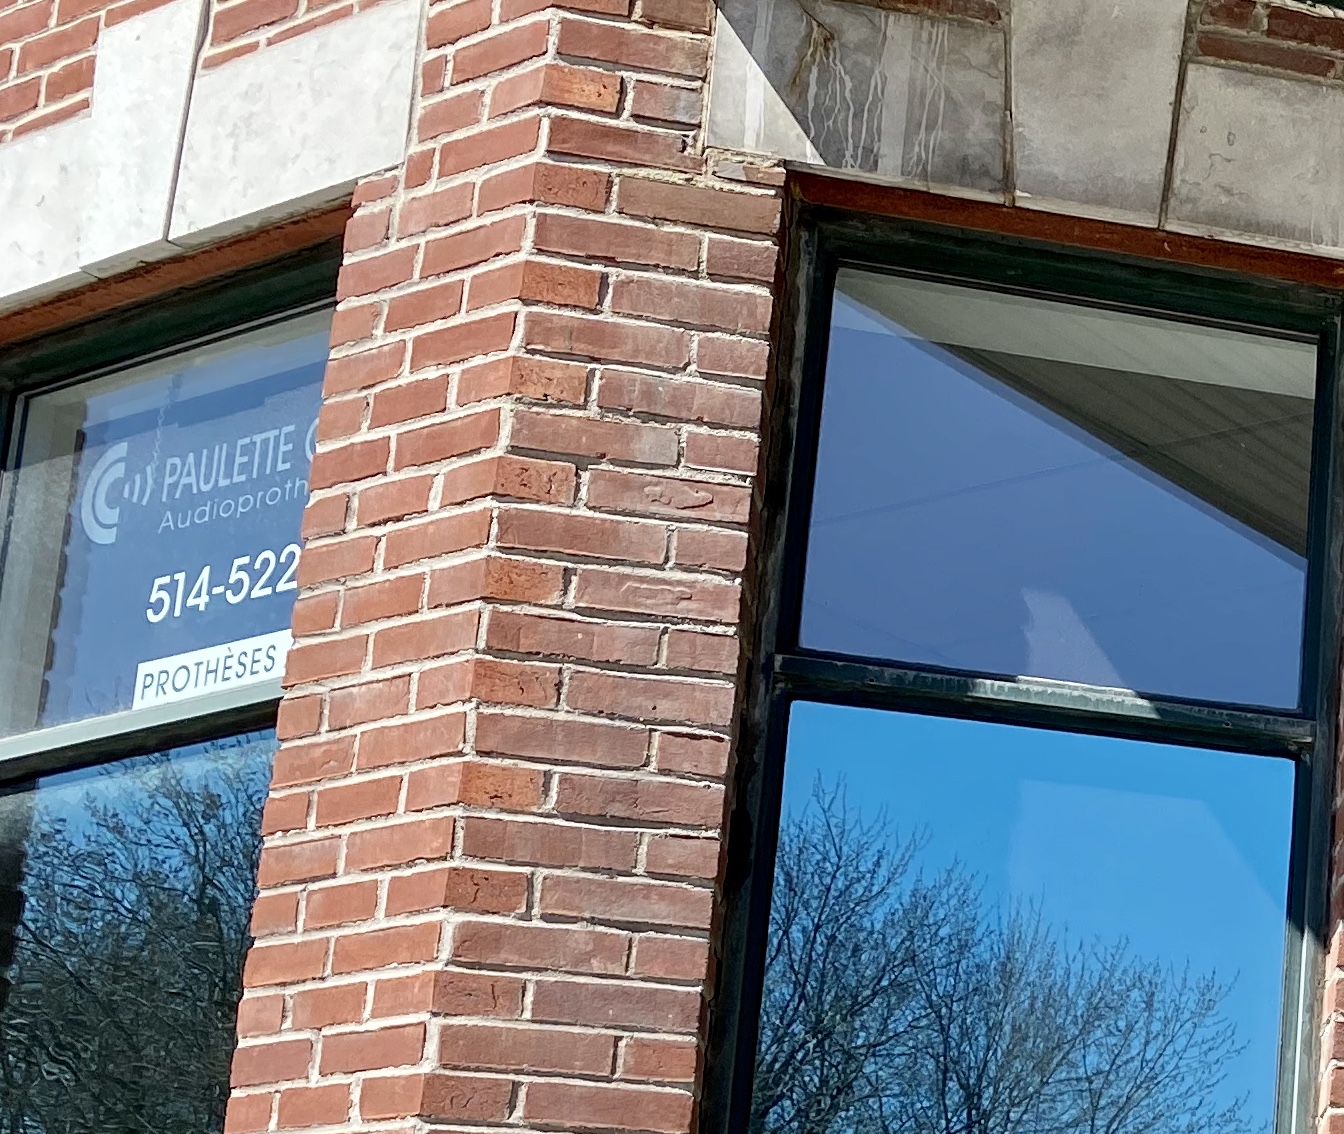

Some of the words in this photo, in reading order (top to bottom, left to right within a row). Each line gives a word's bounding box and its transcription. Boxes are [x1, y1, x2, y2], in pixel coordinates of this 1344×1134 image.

[162, 425, 295, 501] PAULETTE
[157, 477, 308, 534] Audioproth
[146, 543, 301, 623] 514-522
[141, 645, 276, 700] PROTHÈSES
